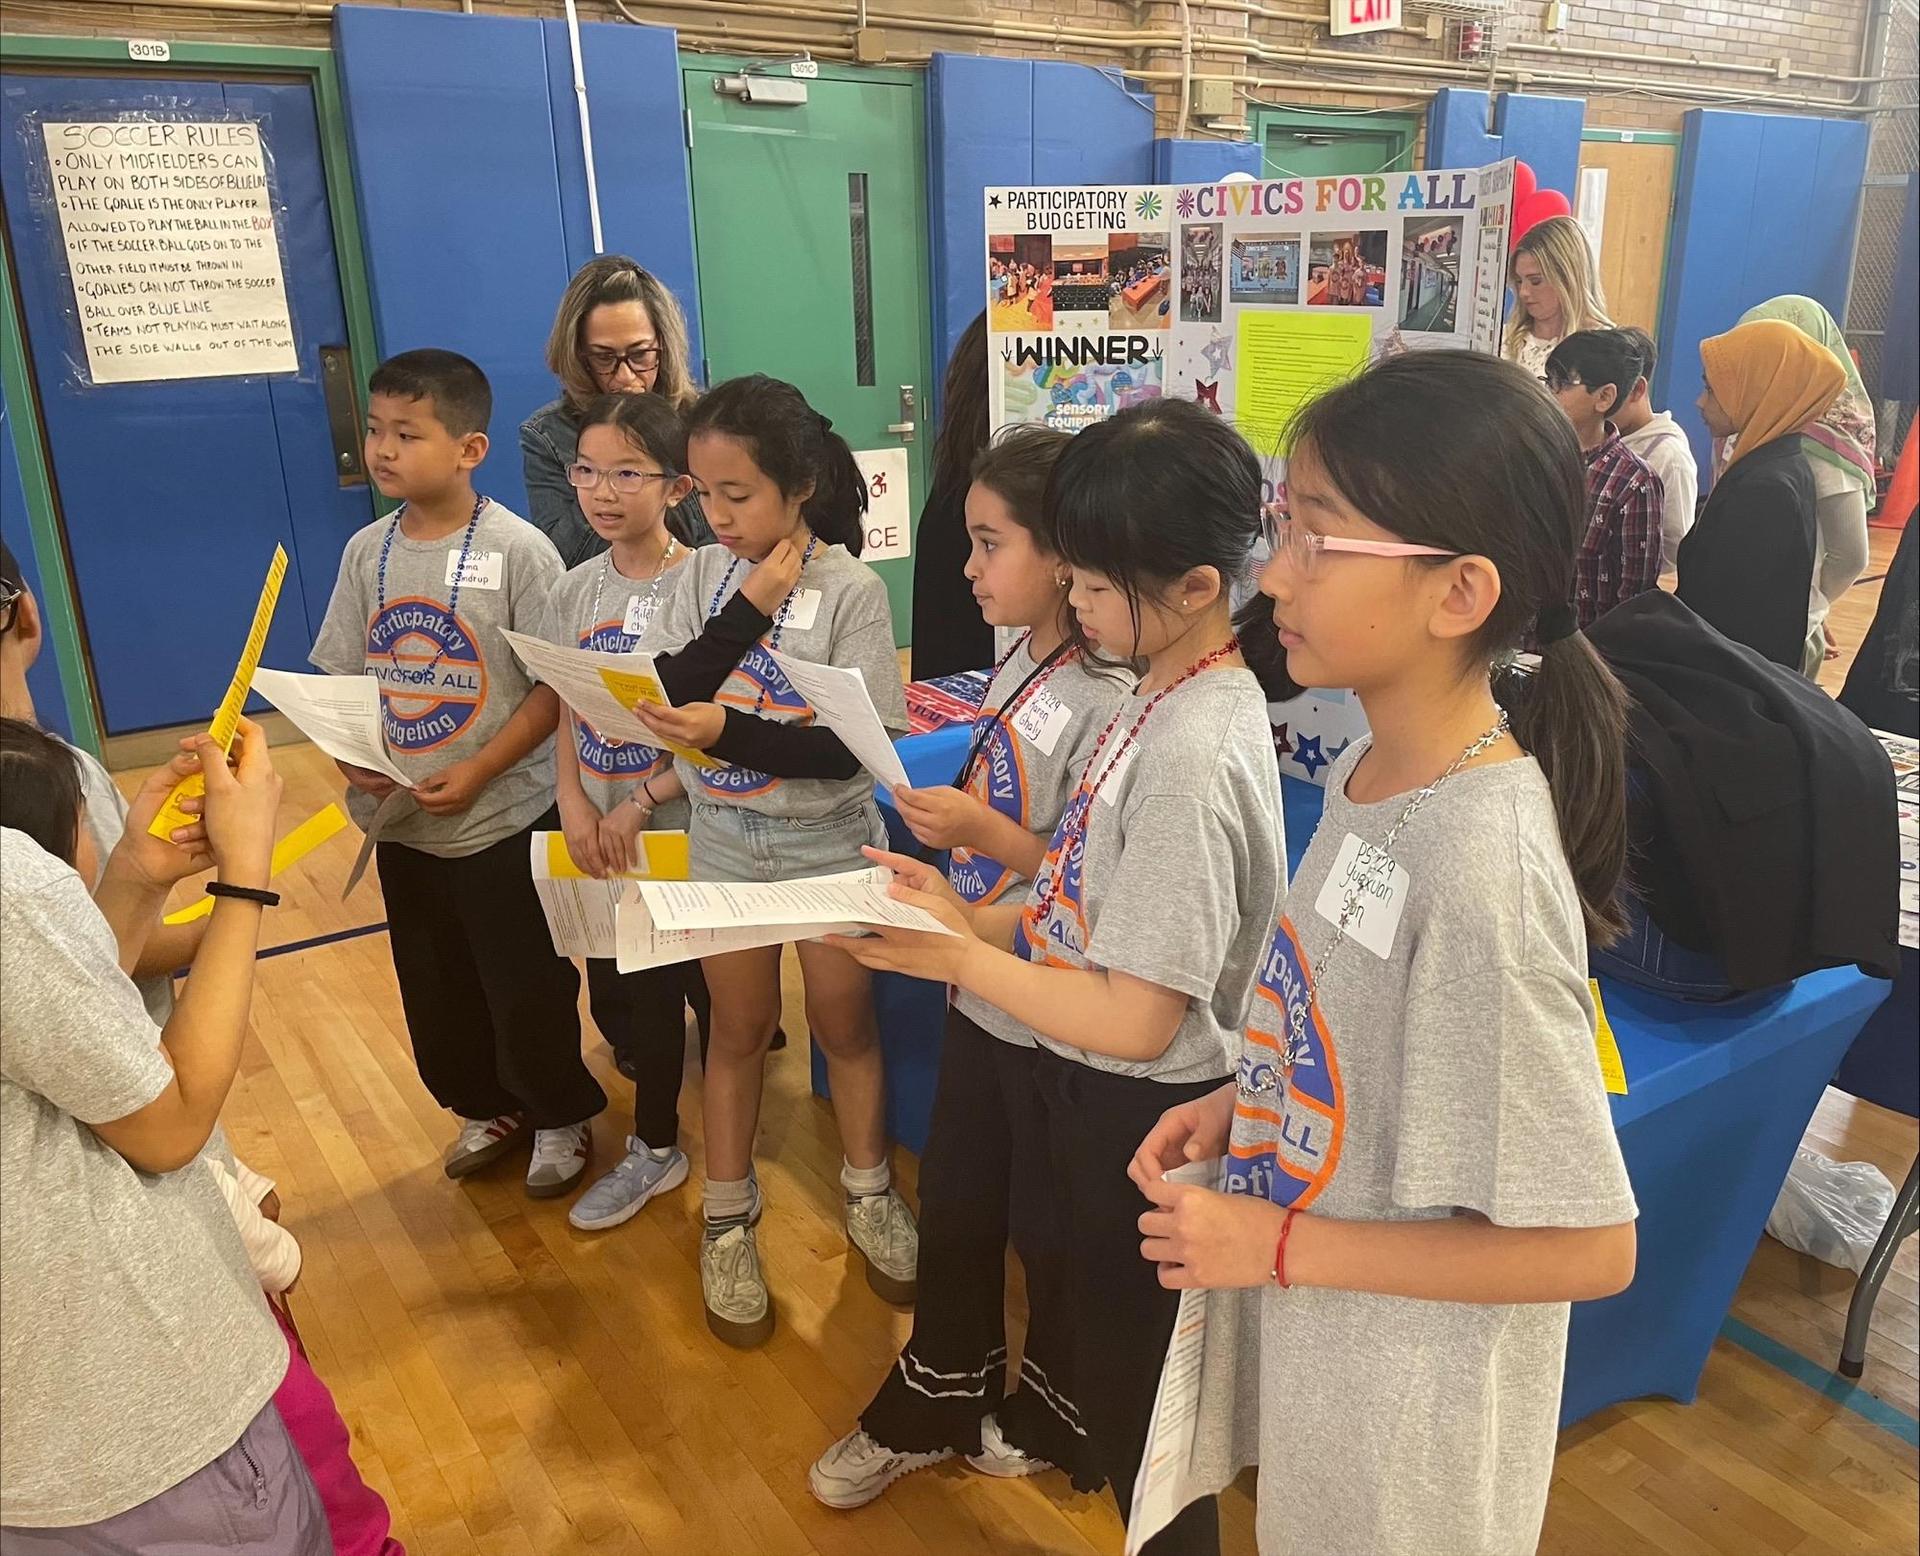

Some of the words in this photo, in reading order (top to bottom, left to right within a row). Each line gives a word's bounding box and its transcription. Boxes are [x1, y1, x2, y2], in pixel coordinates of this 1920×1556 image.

[133, 44, 165, 57] 301B
[63, 125, 178, 150] SOCCER
[186, 125, 255, 147] RULES
[66, 152, 113, 169] ONLY
[120, 153, 219, 169] MIDFIELDERS
[223, 153, 258, 169] CAN
[58, 175, 96, 191] PLAY
[103, 176, 125, 190] ON
[131, 175, 169, 191] BOTH
[173, 176, 208, 189] SIDES
[209, 175, 225, 189] OF
[68, 195, 101, 211] THE
[104, 197, 146, 212] GOALIE
[149, 198, 160, 210] IS
[161, 197, 184, 210] THE
[185, 198, 213, 210] ONLY
[215, 198, 259, 210] PLAYER
[1008, 191, 1128, 210] PARTICIPATORY
[1196, 180, 1304, 217] CIVICS
[1315, 177, 1387, 212] FOR
[1398, 173, 1476, 210] ALL
[68, 221, 127, 233] ALLOWED
[128, 220, 146, 232] TO
[148, 219, 173, 232] PLAY
[174, 219, 195, 231] THE
[194, 218, 219, 231] BALL
[219, 219, 231, 230] IN
[232, 219, 251, 230] THE
[251, 215, 273, 231] BOX
[1027, 211, 1127, 231] BUDGETING
[77, 239, 88, 252] IF
[92, 239, 116, 253] THE
[117, 239, 158, 252] SOCCER
[158, 239, 186, 252] BALL
[186, 239, 212, 252] GOES
[213, 240, 228, 250] ON
[230, 239, 242, 249] TO
[243, 238, 264, 249] THE
[76, 262, 114, 275] OTHER
[119, 262, 147, 274] FIELD
[196, 260, 229, 271] THROWN
[231, 259, 243, 270] IN
[85, 281, 137, 300] GOALIES
[139, 281, 161, 294] CAN
[164, 280, 186, 293] NOT
[190, 279, 224, 292] THROW
[225, 278, 242, 290] THE
[245, 277, 277, 290] SOCCER
[84, 304, 116, 319] BALL
[117, 304, 146, 317] OVER
[148, 300, 182, 316] BLUE
[183, 300, 213, 314] LINE
[93, 322, 133, 338] TEAMS
[137, 323, 160, 336] NOT
[163, 320, 209, 334] PLAYING
[210, 321, 235, 333] MUST
[236, 319, 259, 330] WAIT
[260, 319, 288, 330] ALONG
[94, 344, 124, 357] THE
[129, 343, 161, 355] SIDE
[208, 339, 230, 351] OUT
[233, 339, 247, 349] OF
[248, 338, 272, 348] THE
[1016, 335, 1149, 366] WINNER
[441, 673, 478, 689] ALL
